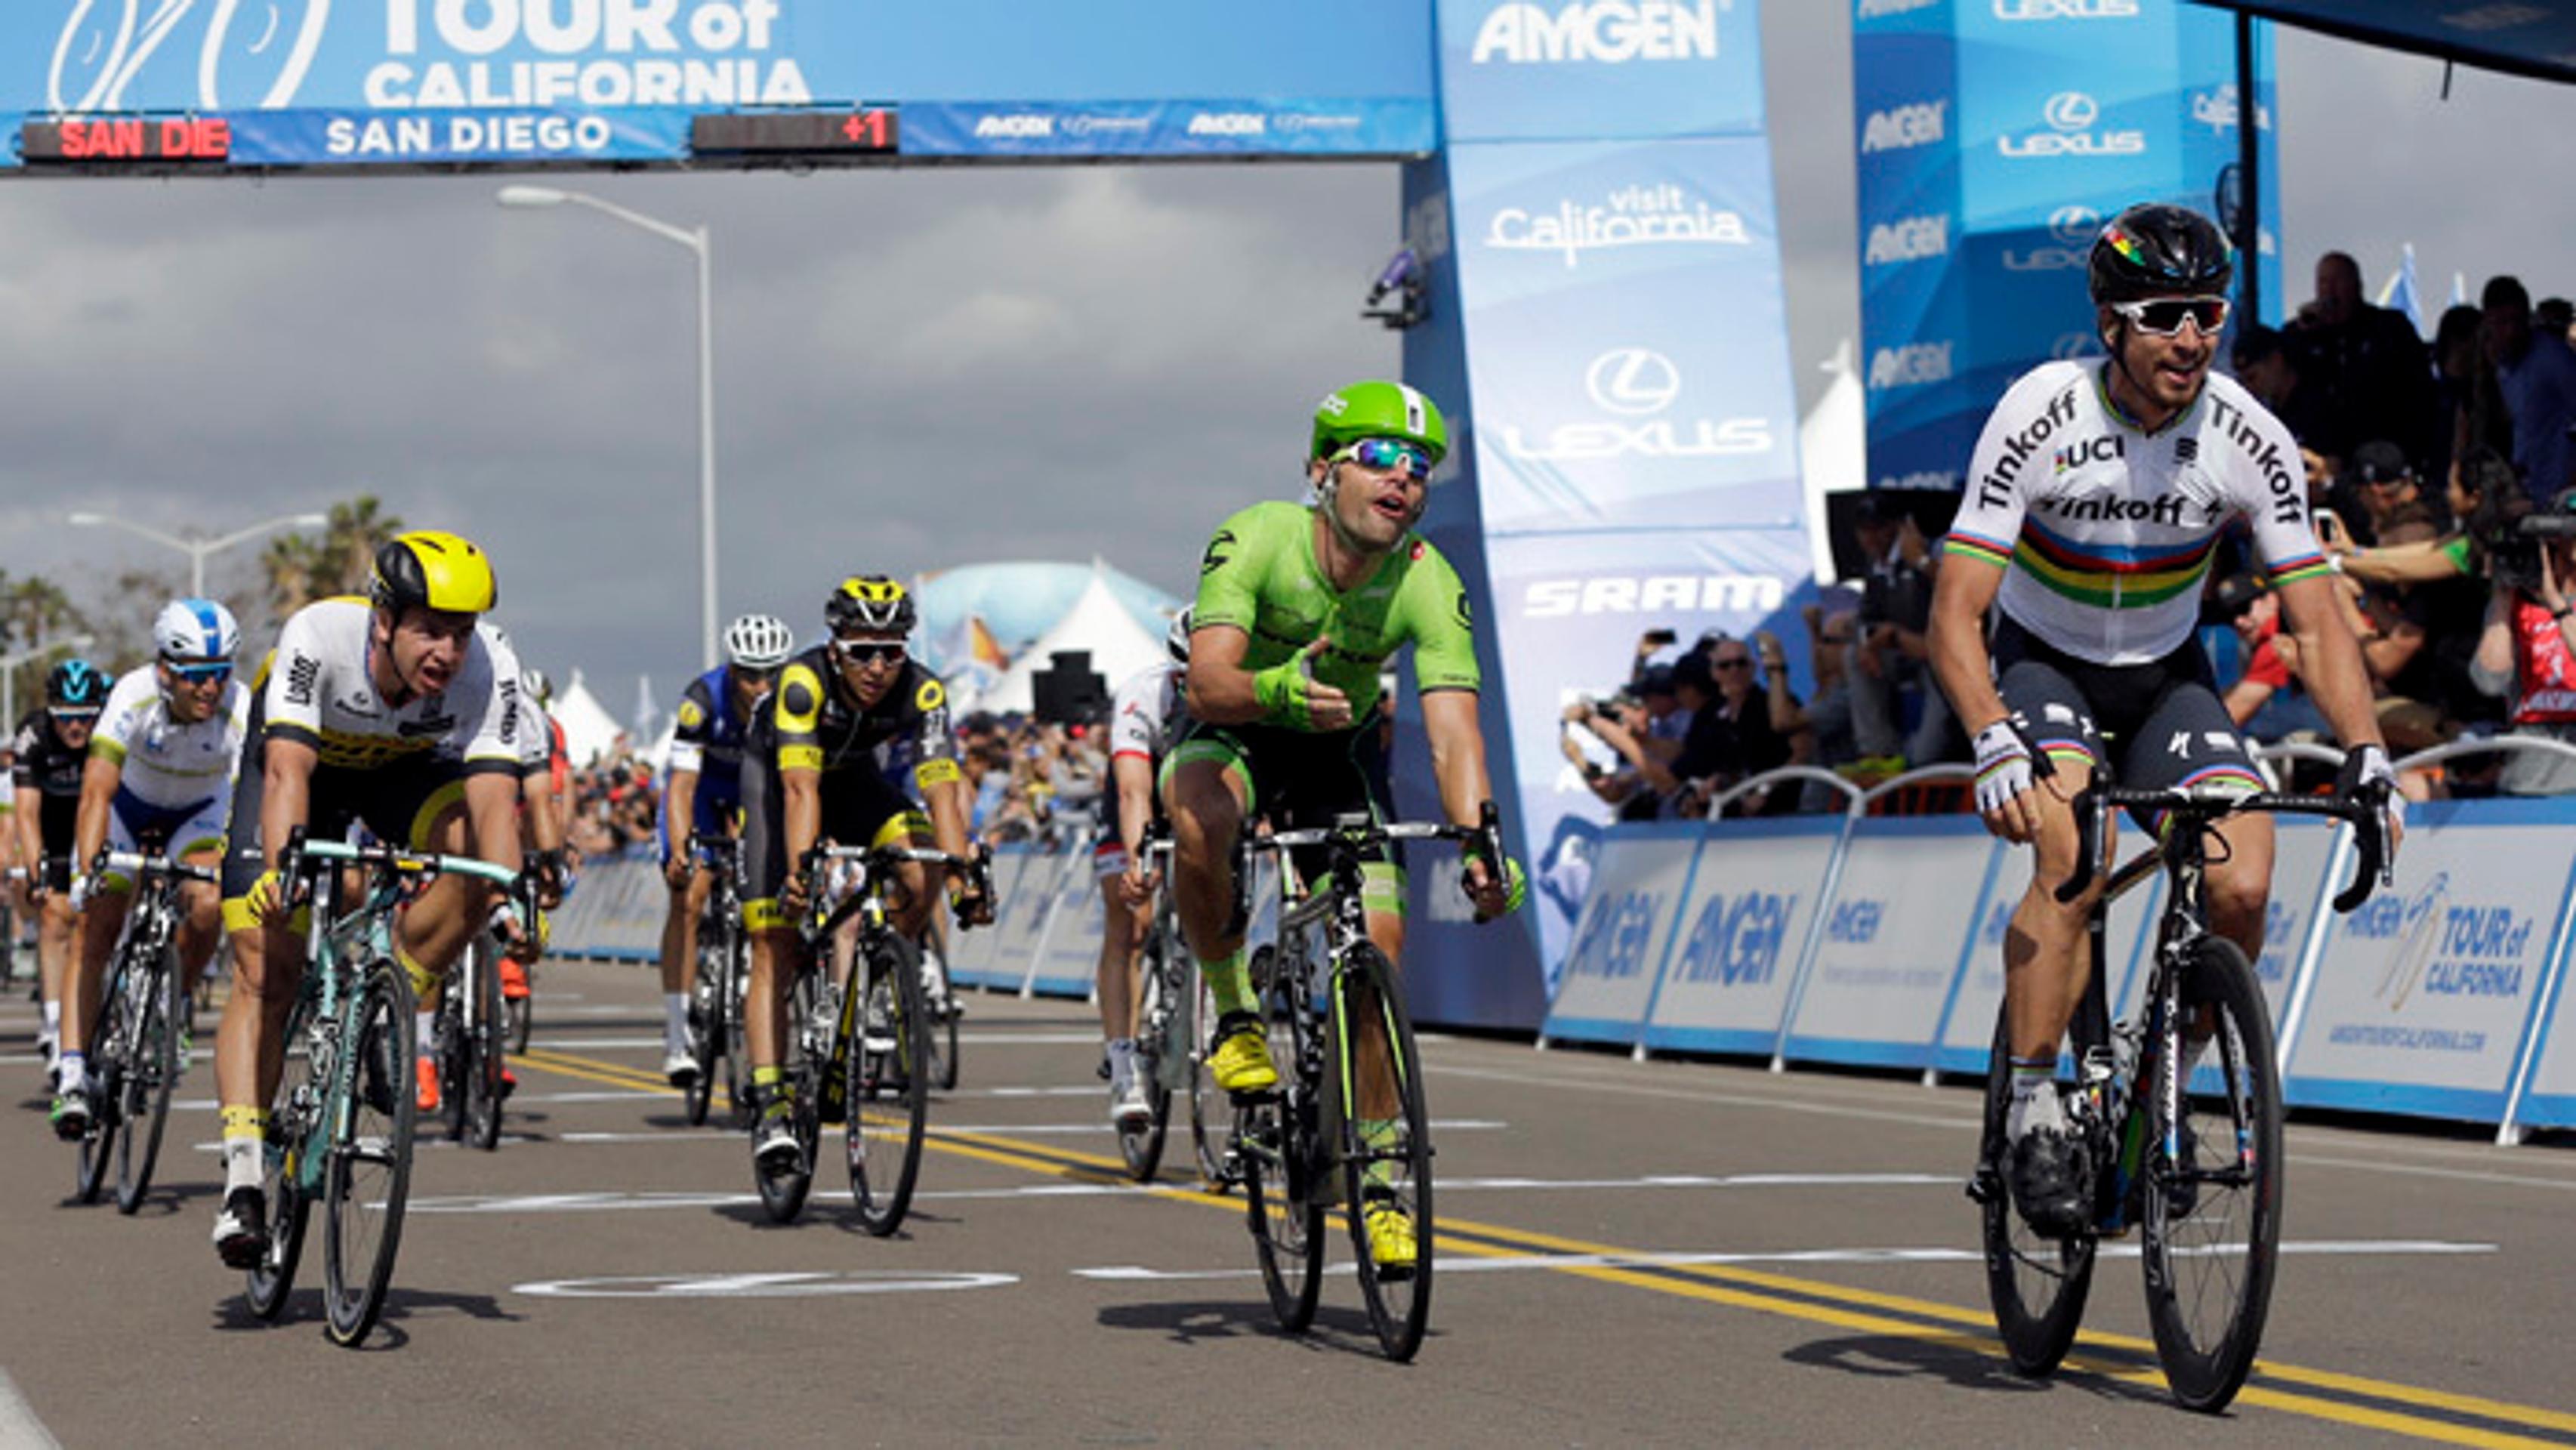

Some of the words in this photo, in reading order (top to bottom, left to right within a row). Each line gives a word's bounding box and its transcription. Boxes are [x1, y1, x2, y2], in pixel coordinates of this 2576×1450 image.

[386, 0, 682, 55] TOUR
[689, 0, 779, 51] of
[1471, 0, 1718, 63] AMGEN
[364, 60, 813, 107] CALIFORNIA
[60, 118, 145, 159] SAN
[161, 118, 232, 157] DIE
[327, 118, 431, 156] SAN
[450, 116, 611, 153] DIEGO
[842, 109, 886, 149] +1
[1998, 130, 2146, 157] LEXUS
[1609, 184, 1684, 211] visit
[1488, 199, 1751, 267] California
[1507, 418, 1773, 459] LEXUS
[1978, 389, 2076, 511] Tinkoff
[2067, 434, 2125, 468] UCI
[2207, 392, 2302, 524] Tinkoff
[1524, 575, 1784, 617] SRAM
[2440, 906, 2512, 958] TOUR
